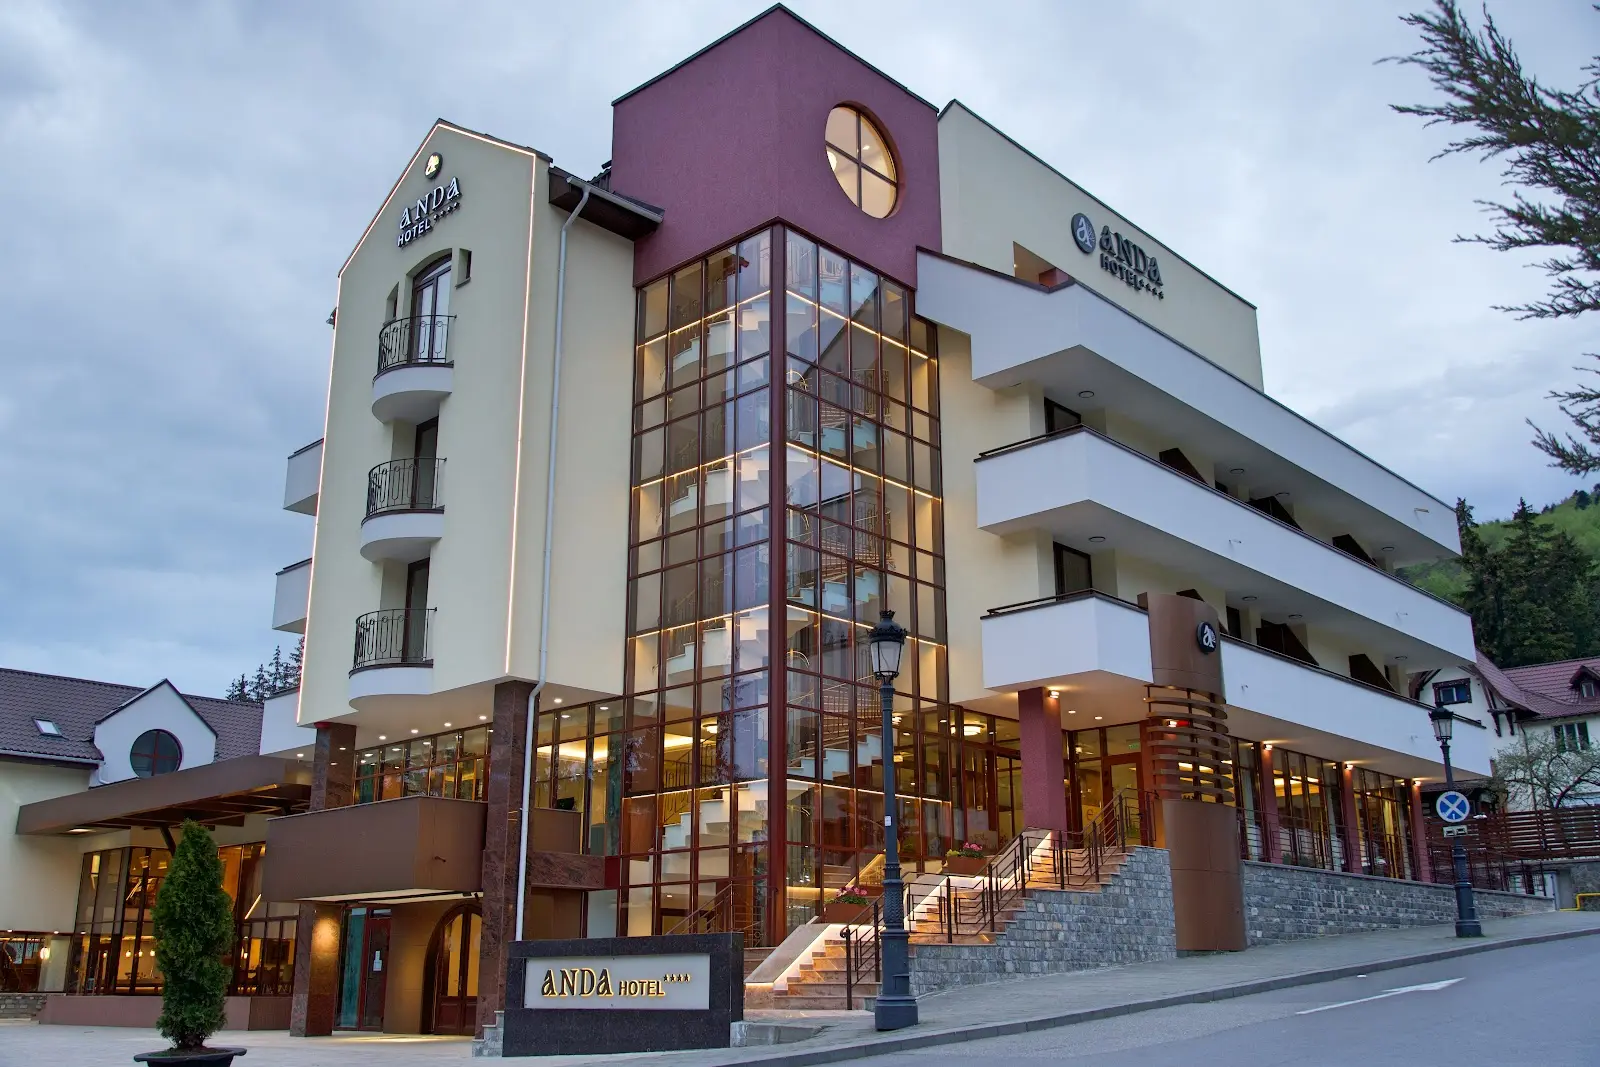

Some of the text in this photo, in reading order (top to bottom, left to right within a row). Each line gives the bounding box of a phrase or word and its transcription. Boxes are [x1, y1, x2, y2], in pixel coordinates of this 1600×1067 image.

[397, 218, 432, 247] HOTEL
[1100, 253, 1141, 291] HOTEL
[618, 980, 665, 996] HOTEL
